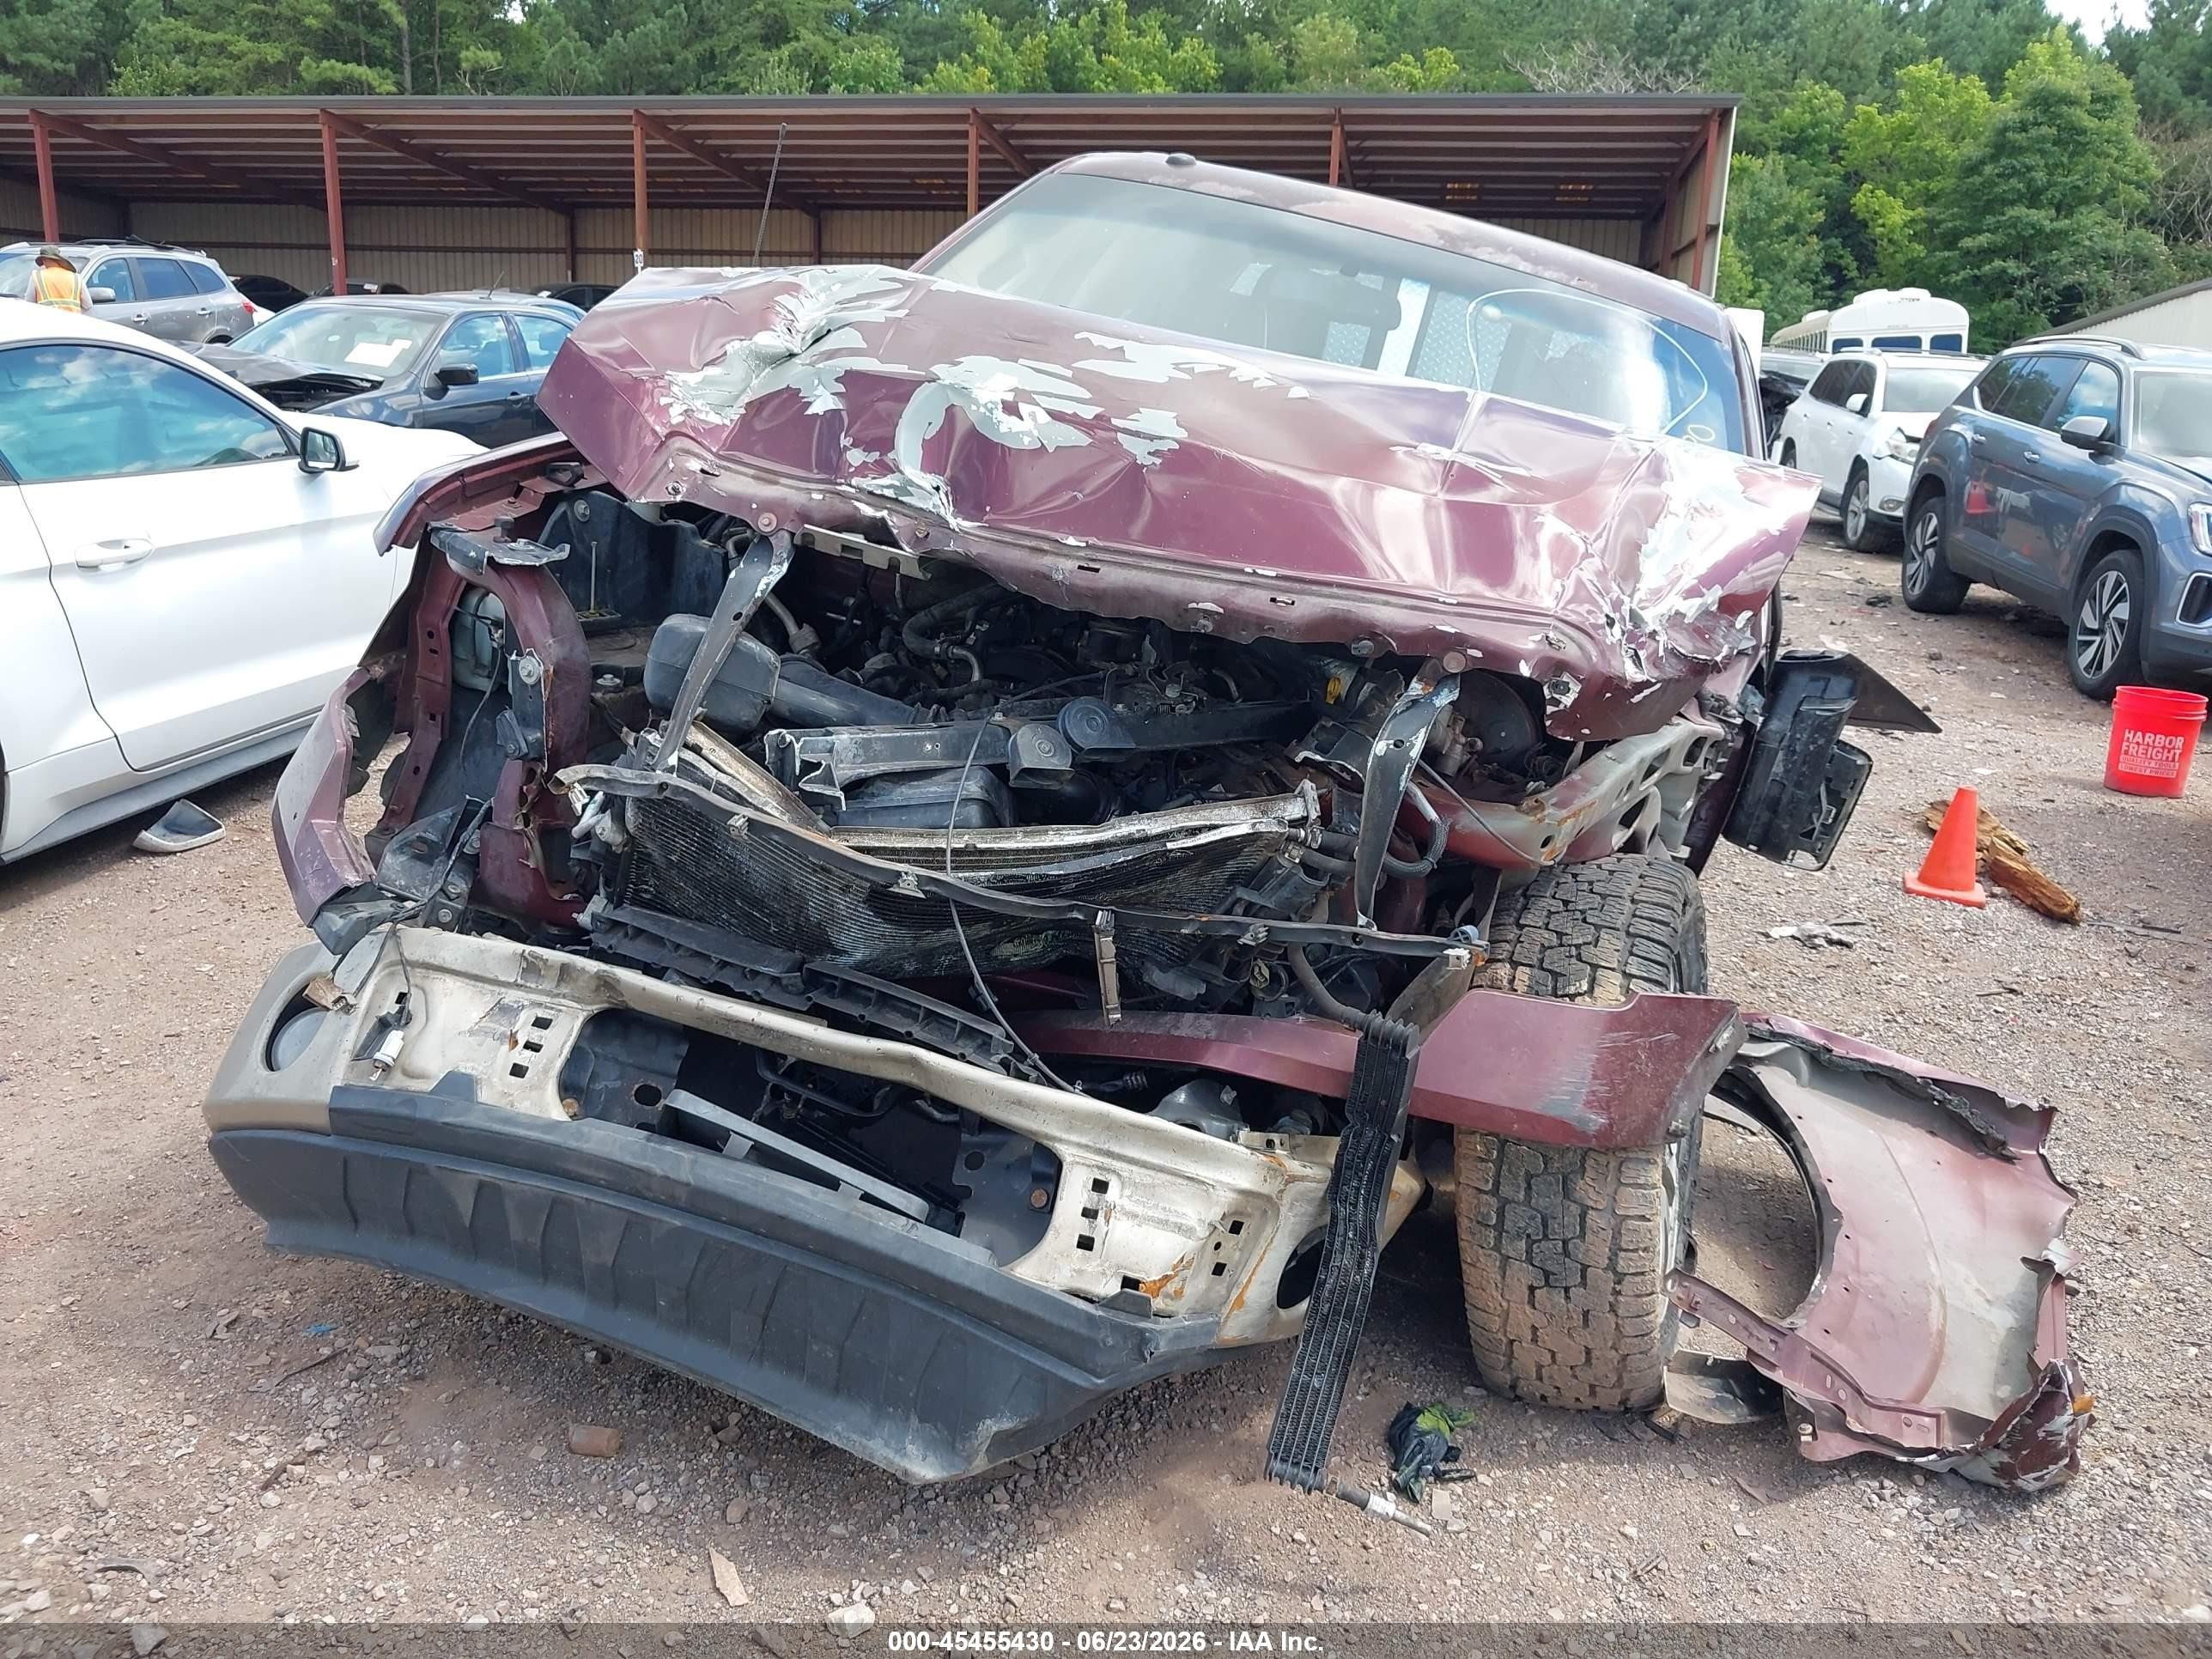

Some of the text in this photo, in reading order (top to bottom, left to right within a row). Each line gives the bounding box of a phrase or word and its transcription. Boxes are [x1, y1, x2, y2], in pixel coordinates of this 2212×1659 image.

[635, 253, 643, 264] 20
[2123, 728, 2185, 750] HARBOR
[2121, 741, 2183, 763] FREIGHT
